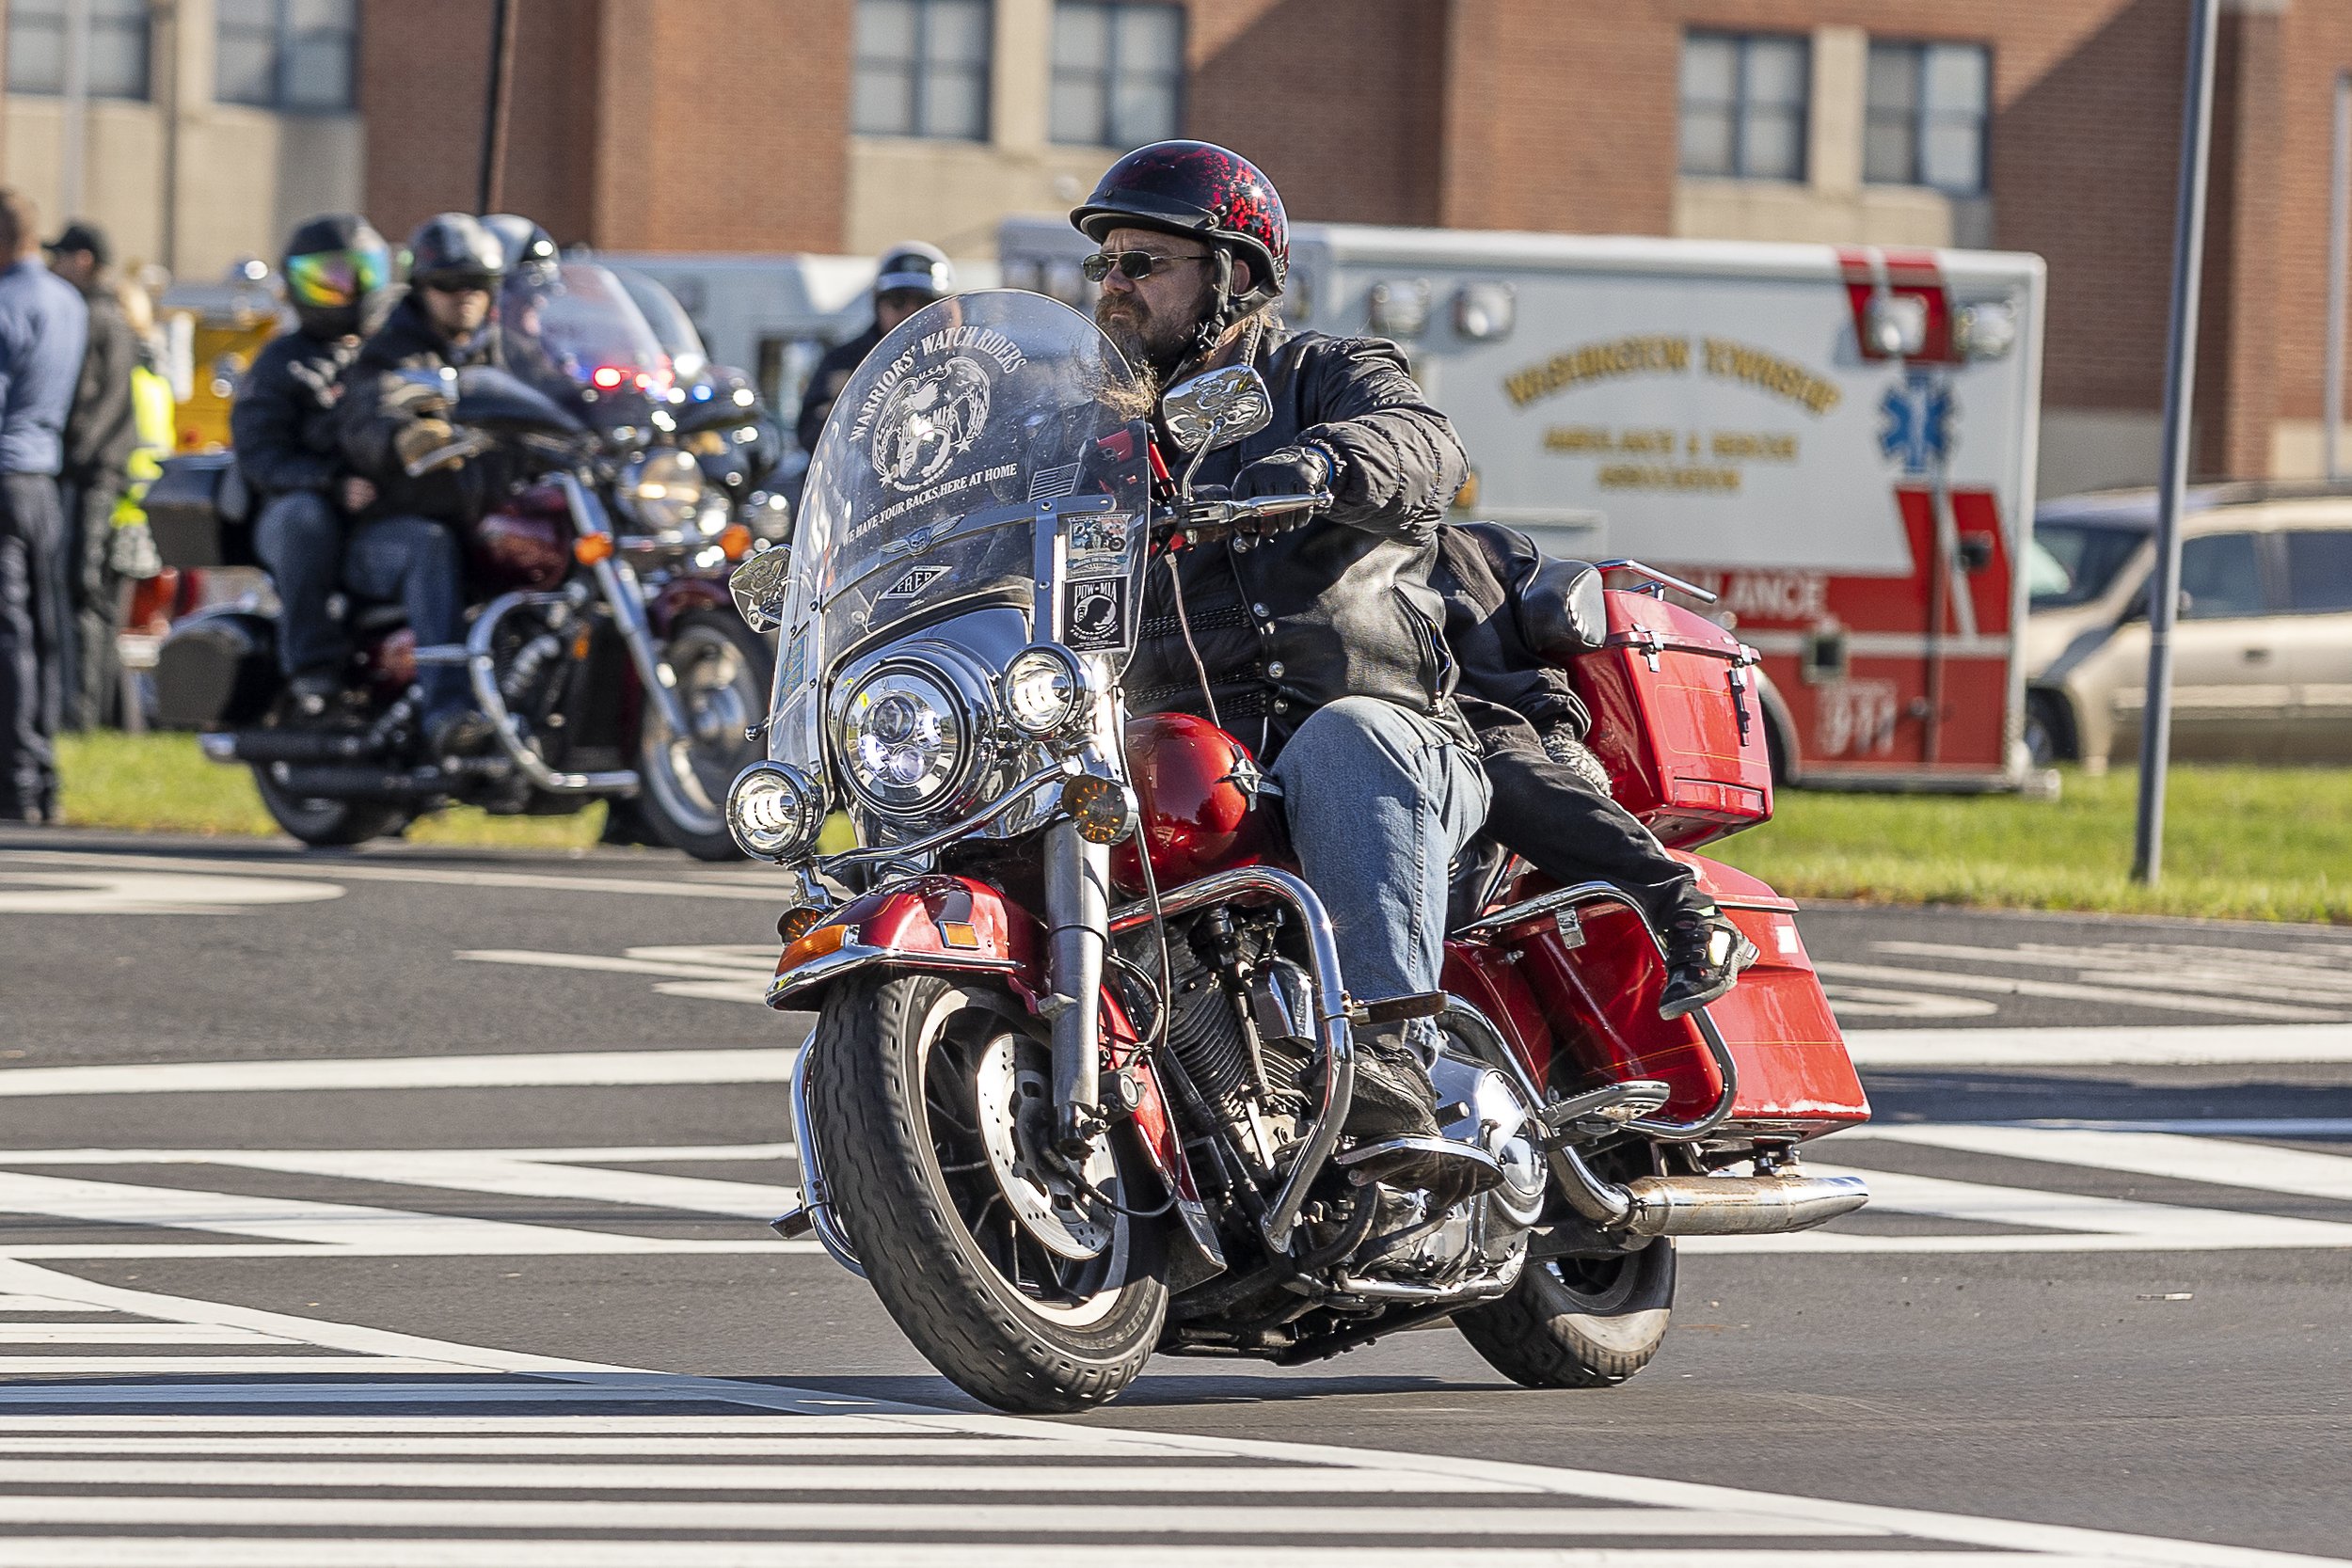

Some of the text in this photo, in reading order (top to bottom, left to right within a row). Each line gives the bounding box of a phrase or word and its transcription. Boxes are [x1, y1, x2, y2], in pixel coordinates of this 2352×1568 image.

[849, 325, 1027, 443] WARRIORS' WATCH RIDERS
[855, 515, 881, 539] HAVE
[879, 500, 907, 525] YOUR
[940, 478, 968, 499] HERE
[968, 471, 983, 487] AT
[985, 463, 1018, 482] HOME
